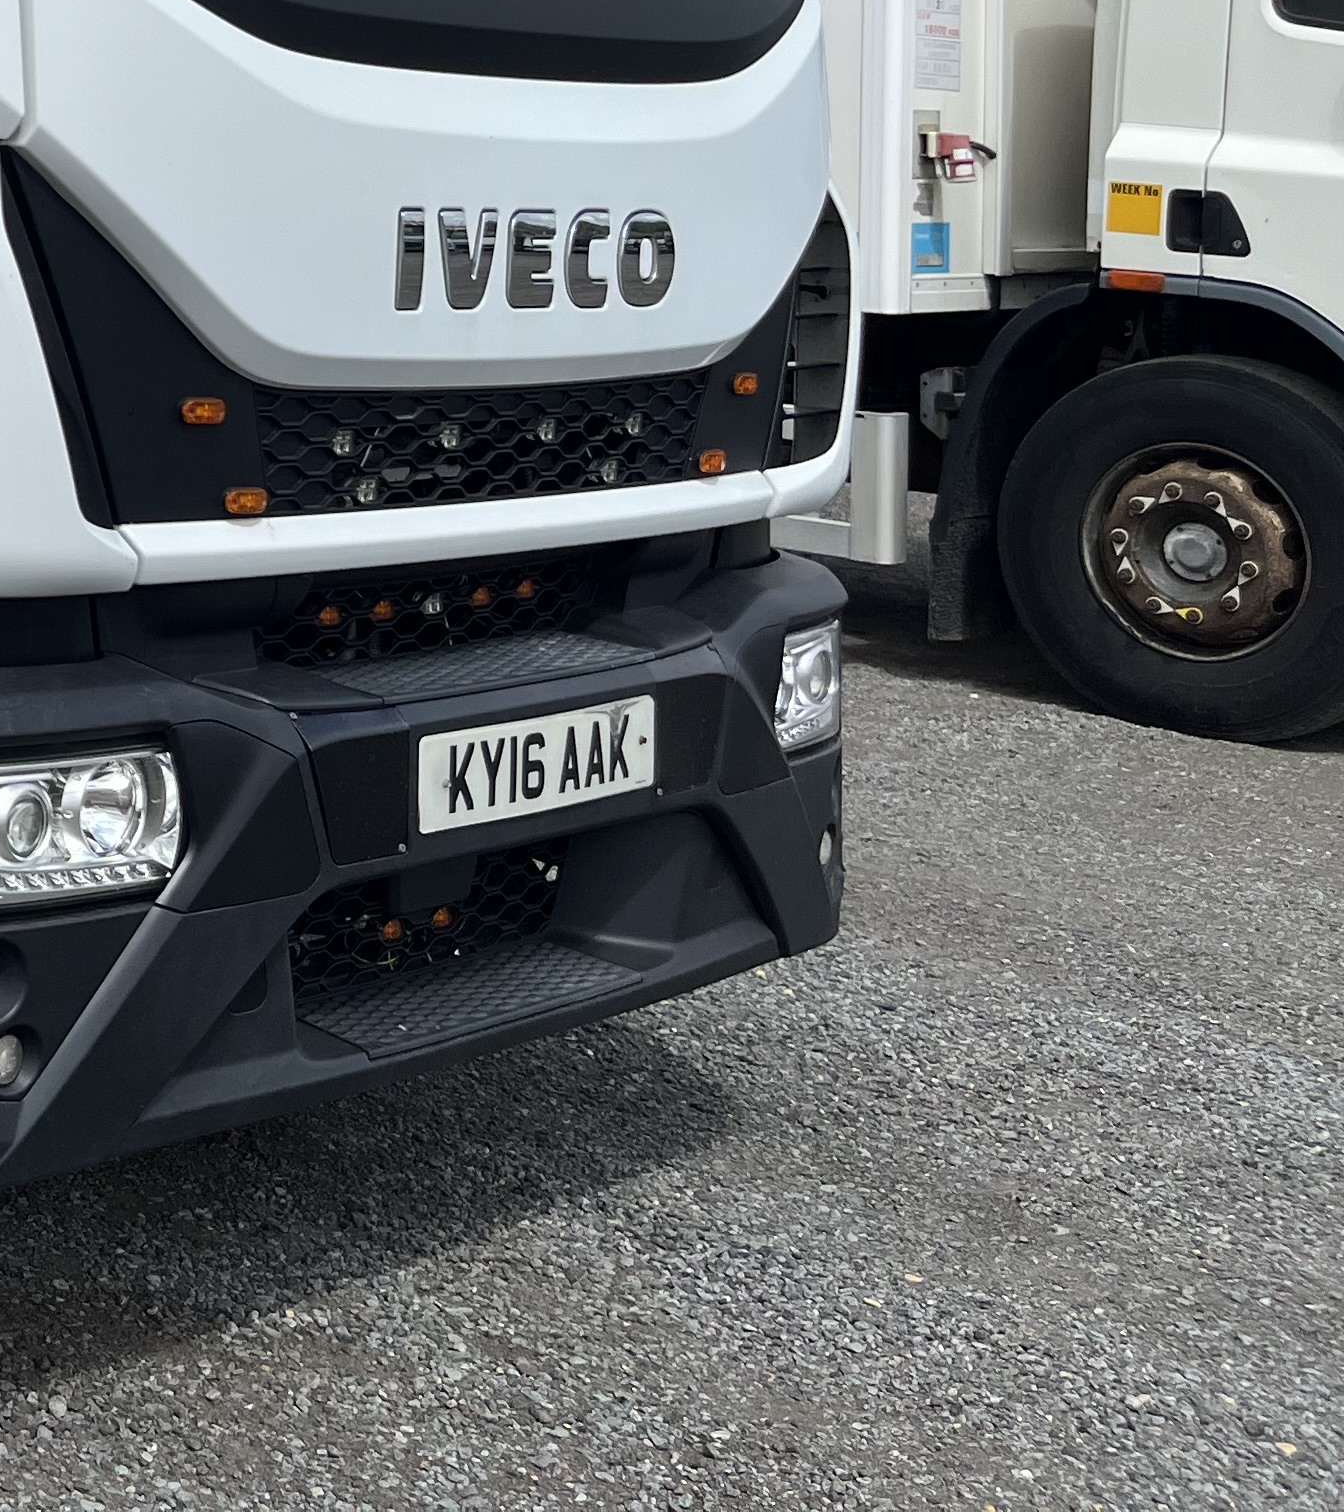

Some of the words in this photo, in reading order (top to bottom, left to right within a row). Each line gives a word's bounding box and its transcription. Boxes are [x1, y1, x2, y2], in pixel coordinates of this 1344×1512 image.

[1111, 183, 1140, 196] WEEK
[1144, 185, 1158, 196] No
[394, 206, 676, 311] IVECO
[449, 732, 546, 814] KY16
[558, 714, 630, 794] AAK
